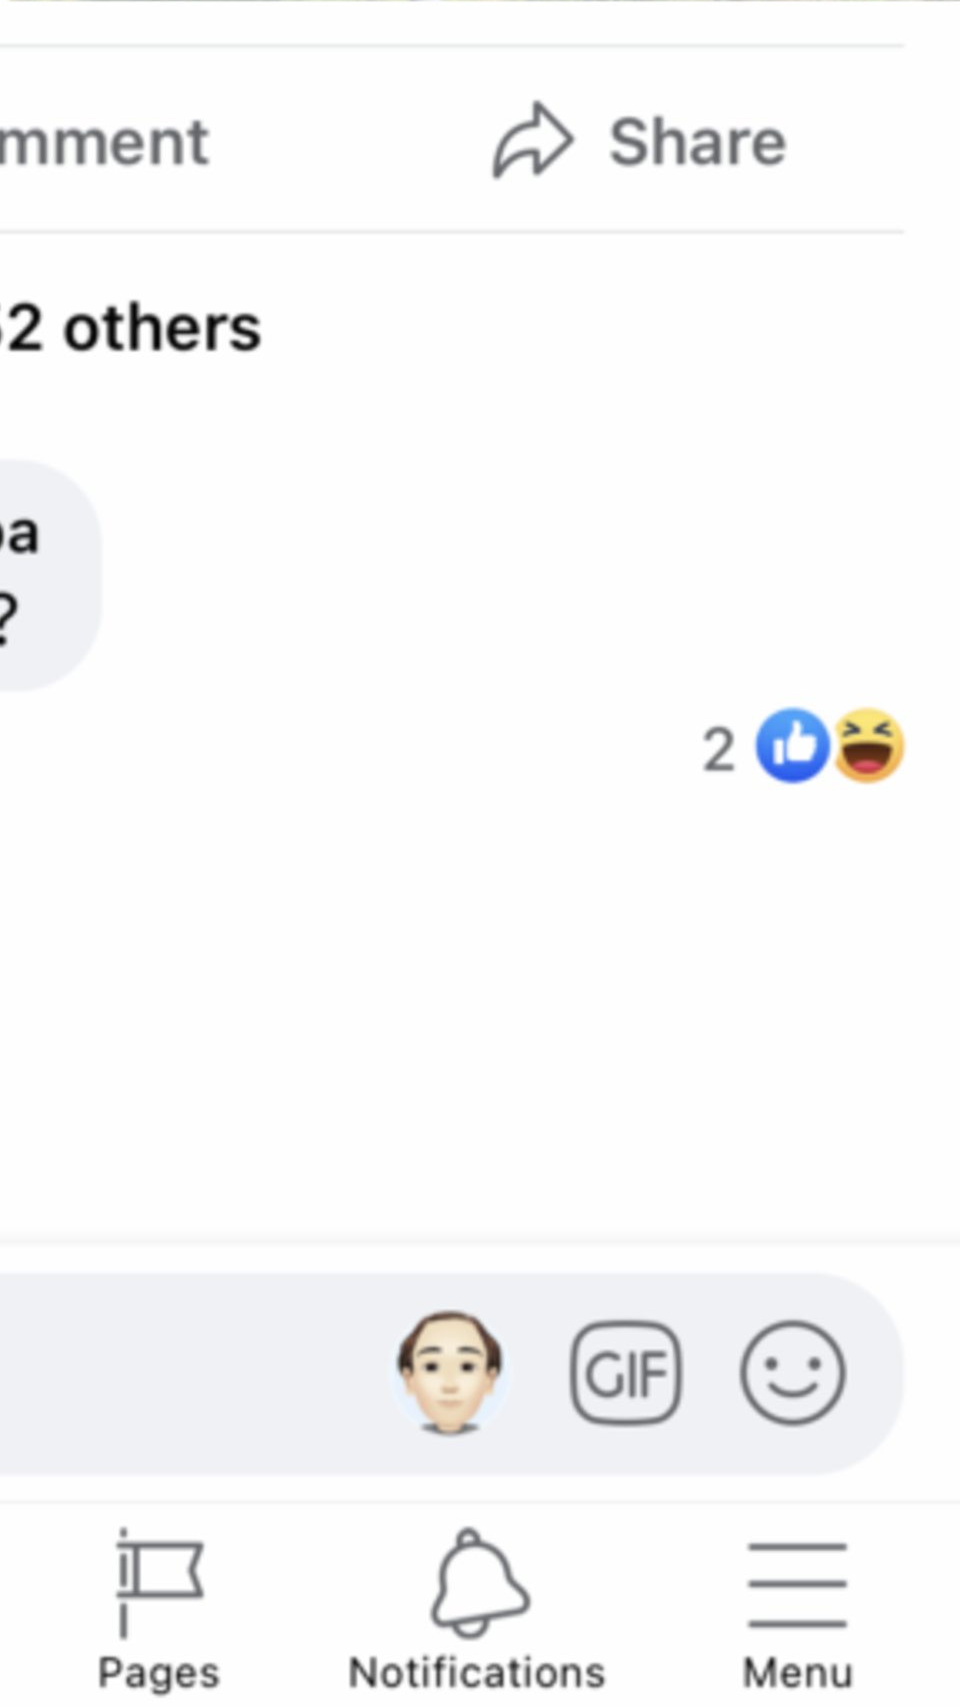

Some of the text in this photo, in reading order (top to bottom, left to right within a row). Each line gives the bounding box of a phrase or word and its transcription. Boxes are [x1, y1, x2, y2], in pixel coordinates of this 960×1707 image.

[610, 115, 786, 167] Share
[63, 300, 261, 352] others
[703, 726, 734, 772] 2
[585, 1350, 667, 1398] GIF
[99, 1656, 220, 1697] Pages
[349, 1654, 606, 1689] Notifications
[743, 1656, 853, 1689] Menu
